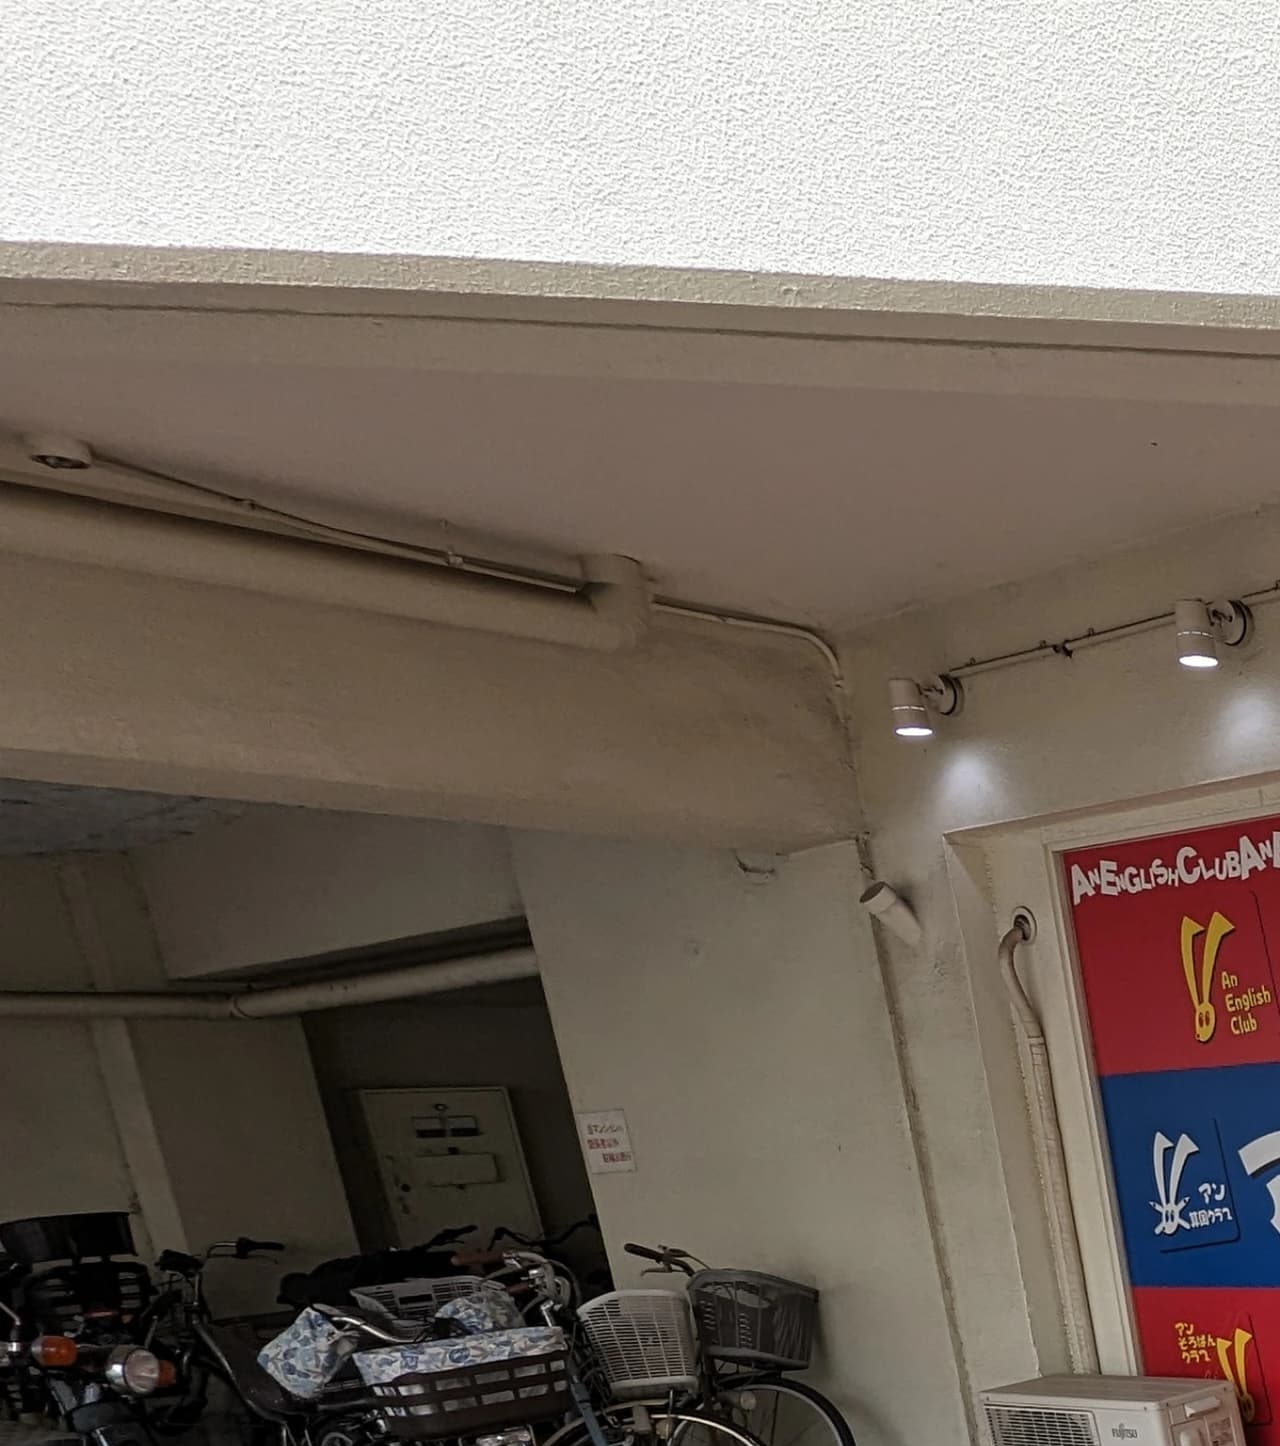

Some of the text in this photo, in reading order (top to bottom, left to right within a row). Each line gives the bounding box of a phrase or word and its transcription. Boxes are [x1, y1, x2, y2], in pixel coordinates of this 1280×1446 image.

[1221, 971, 1238, 990] An
[1225, 984, 1271, 1012] English
[1230, 1012, 1257, 1035] Club
[1198, 1182, 1225, 1204] アン
[1174, 1322, 1195, 1336] アン
[1178, 1334, 1216, 1350] そろばん
[1111, 1422, 1138, 1441] FUJITSU
